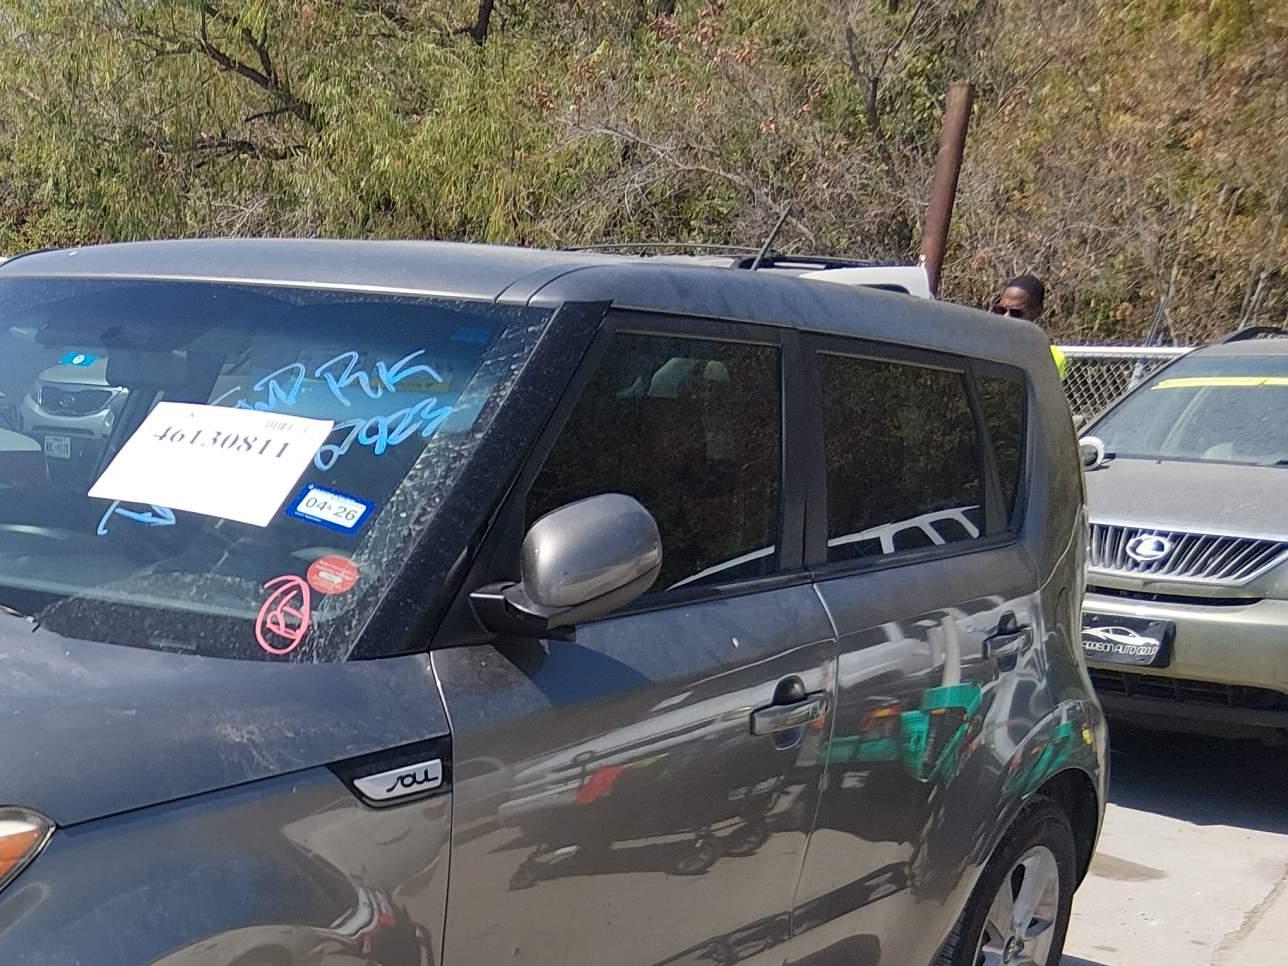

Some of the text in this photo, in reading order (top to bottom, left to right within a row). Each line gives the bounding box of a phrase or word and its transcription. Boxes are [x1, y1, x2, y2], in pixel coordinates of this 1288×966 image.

[153, 426, 290, 459] 46130811
[306, 497, 328, 511] 04
[333, 506, 358, 521] 26
[1114, 643, 1136, 655] AUTO
